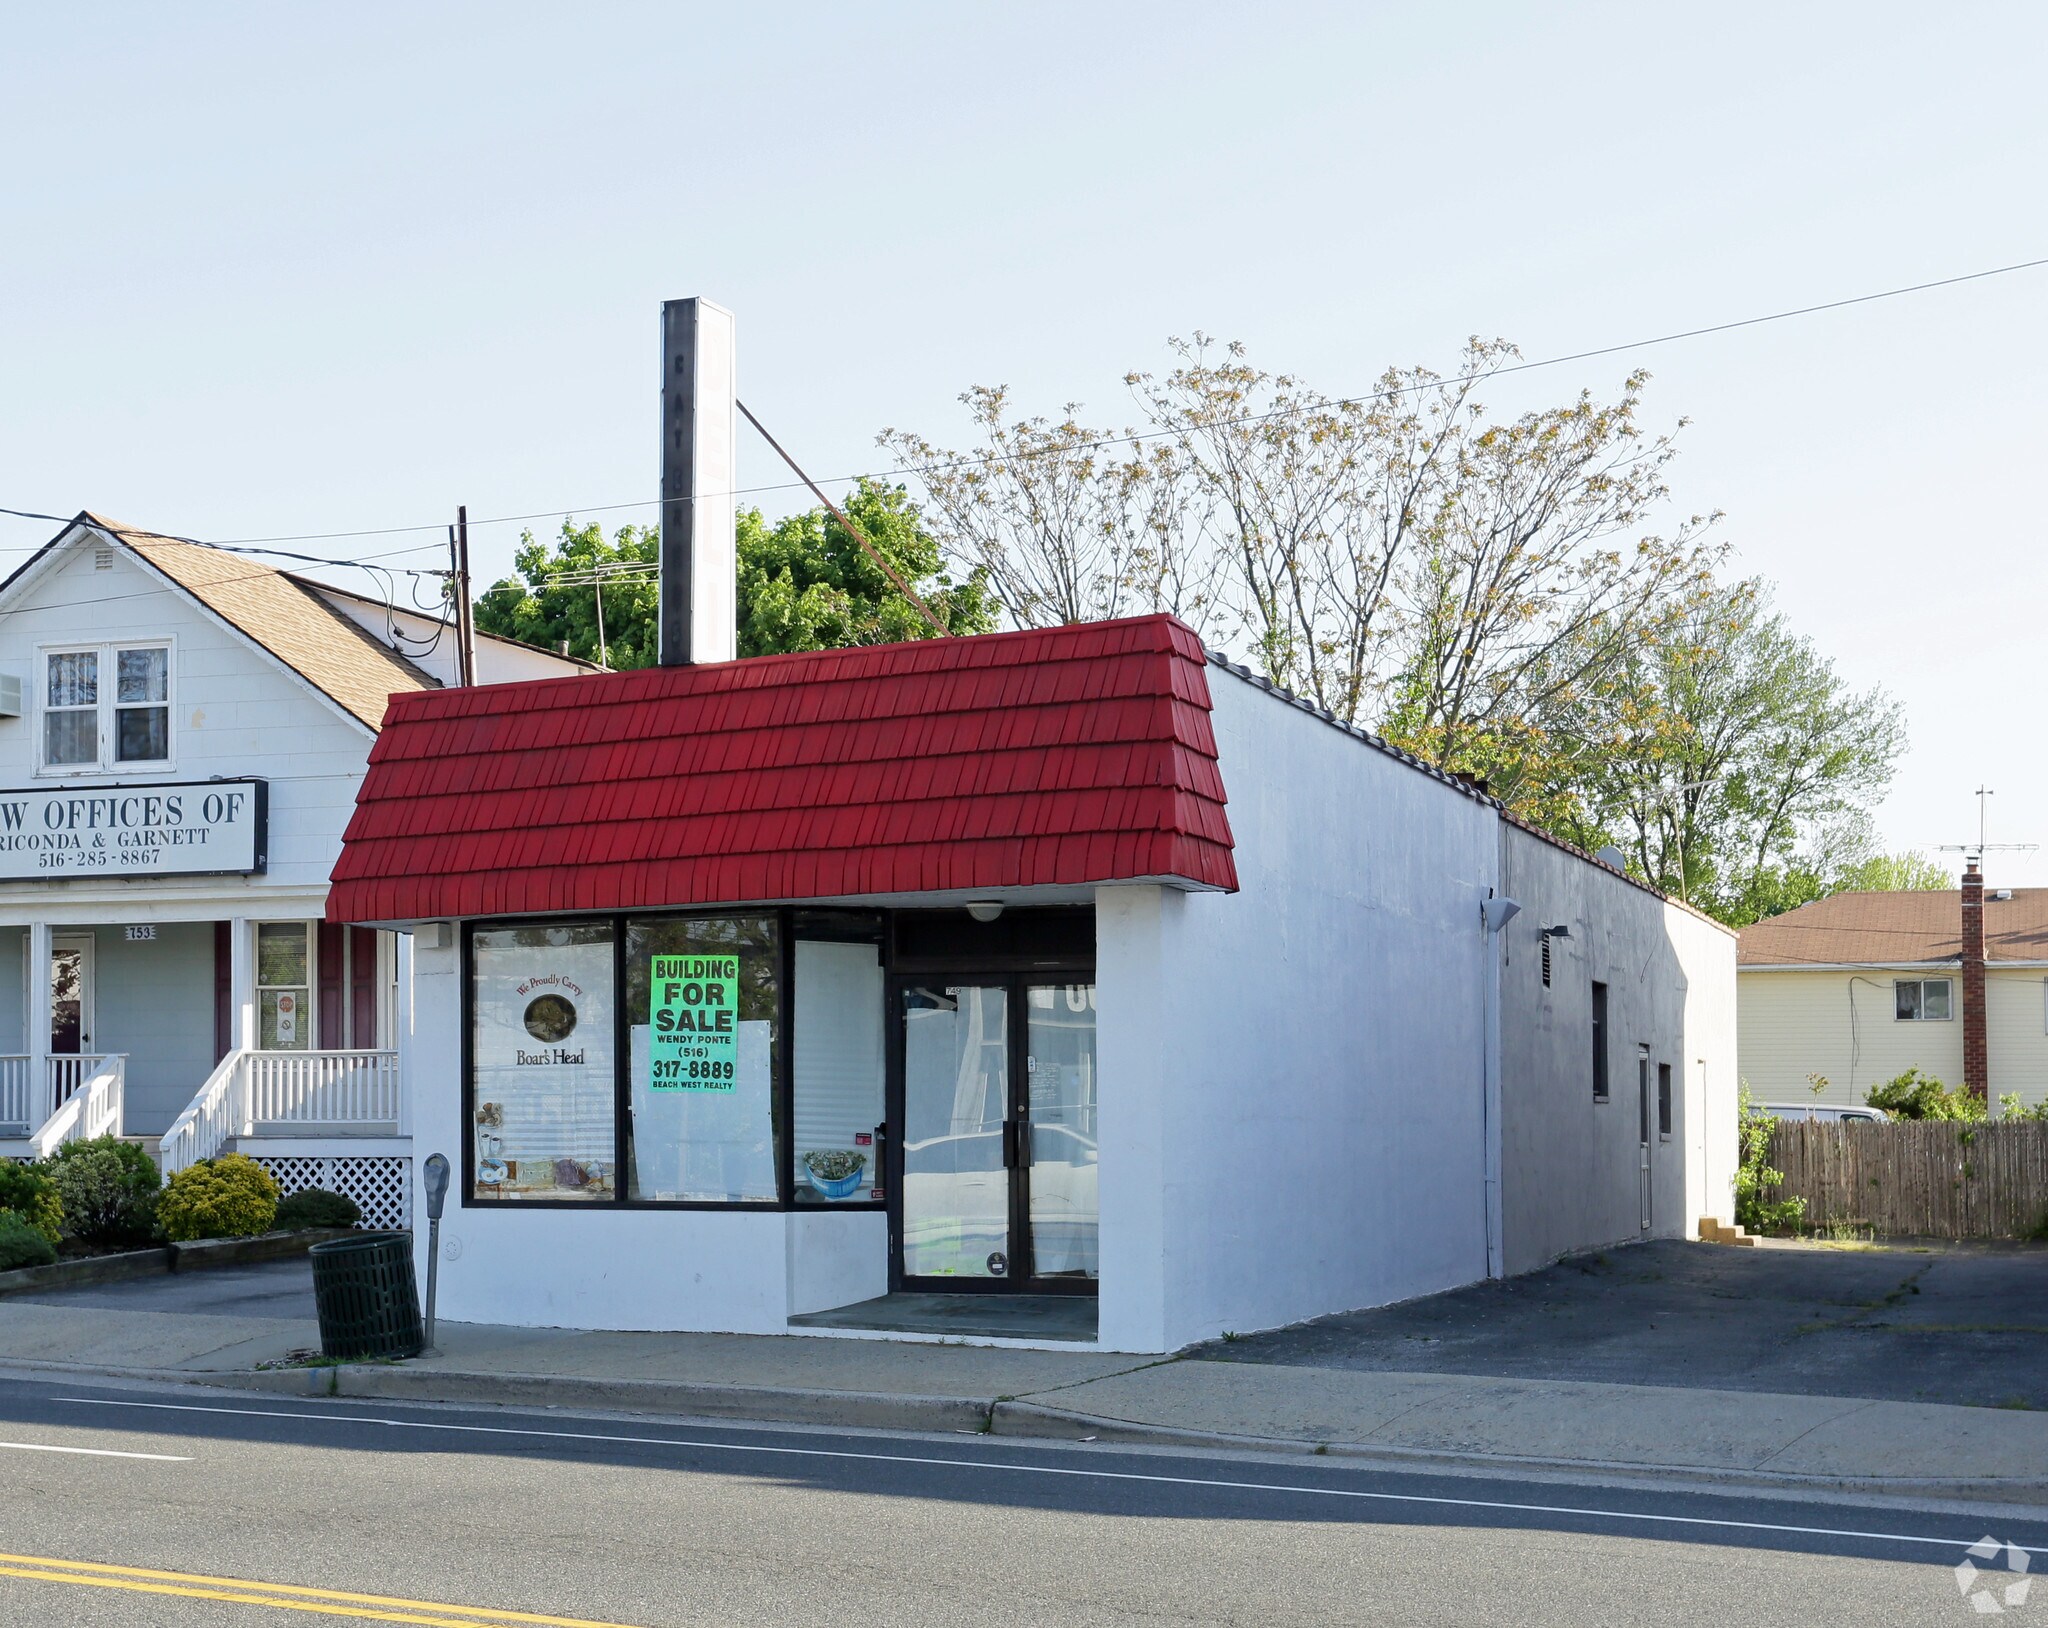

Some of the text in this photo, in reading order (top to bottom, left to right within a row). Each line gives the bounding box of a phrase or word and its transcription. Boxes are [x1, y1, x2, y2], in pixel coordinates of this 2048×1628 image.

[0, 793, 244, 832] W OFFICES OF
[92, 832, 107, 848] &
[117, 828, 210, 848] GARNETT
[39, 849, 161, 868] 516-285-8867
[130, 926, 150, 939] 753
[656, 960, 736, 979] BUILDING
[516, 974, 583, 996] We Proudly Carry
[664, 982, 725, 1005] FOR
[946, 987, 961, 995] 749
[656, 1009, 733, 1032] SALE
[657, 1035, 731, 1044] WENDY PONTE
[516, 1048, 585, 1065] Boar's Head
[678, 1047, 709, 1058] (516)
[653, 1060, 734, 1079] 317-8889
[681, 1081, 702, 1089] WEST
